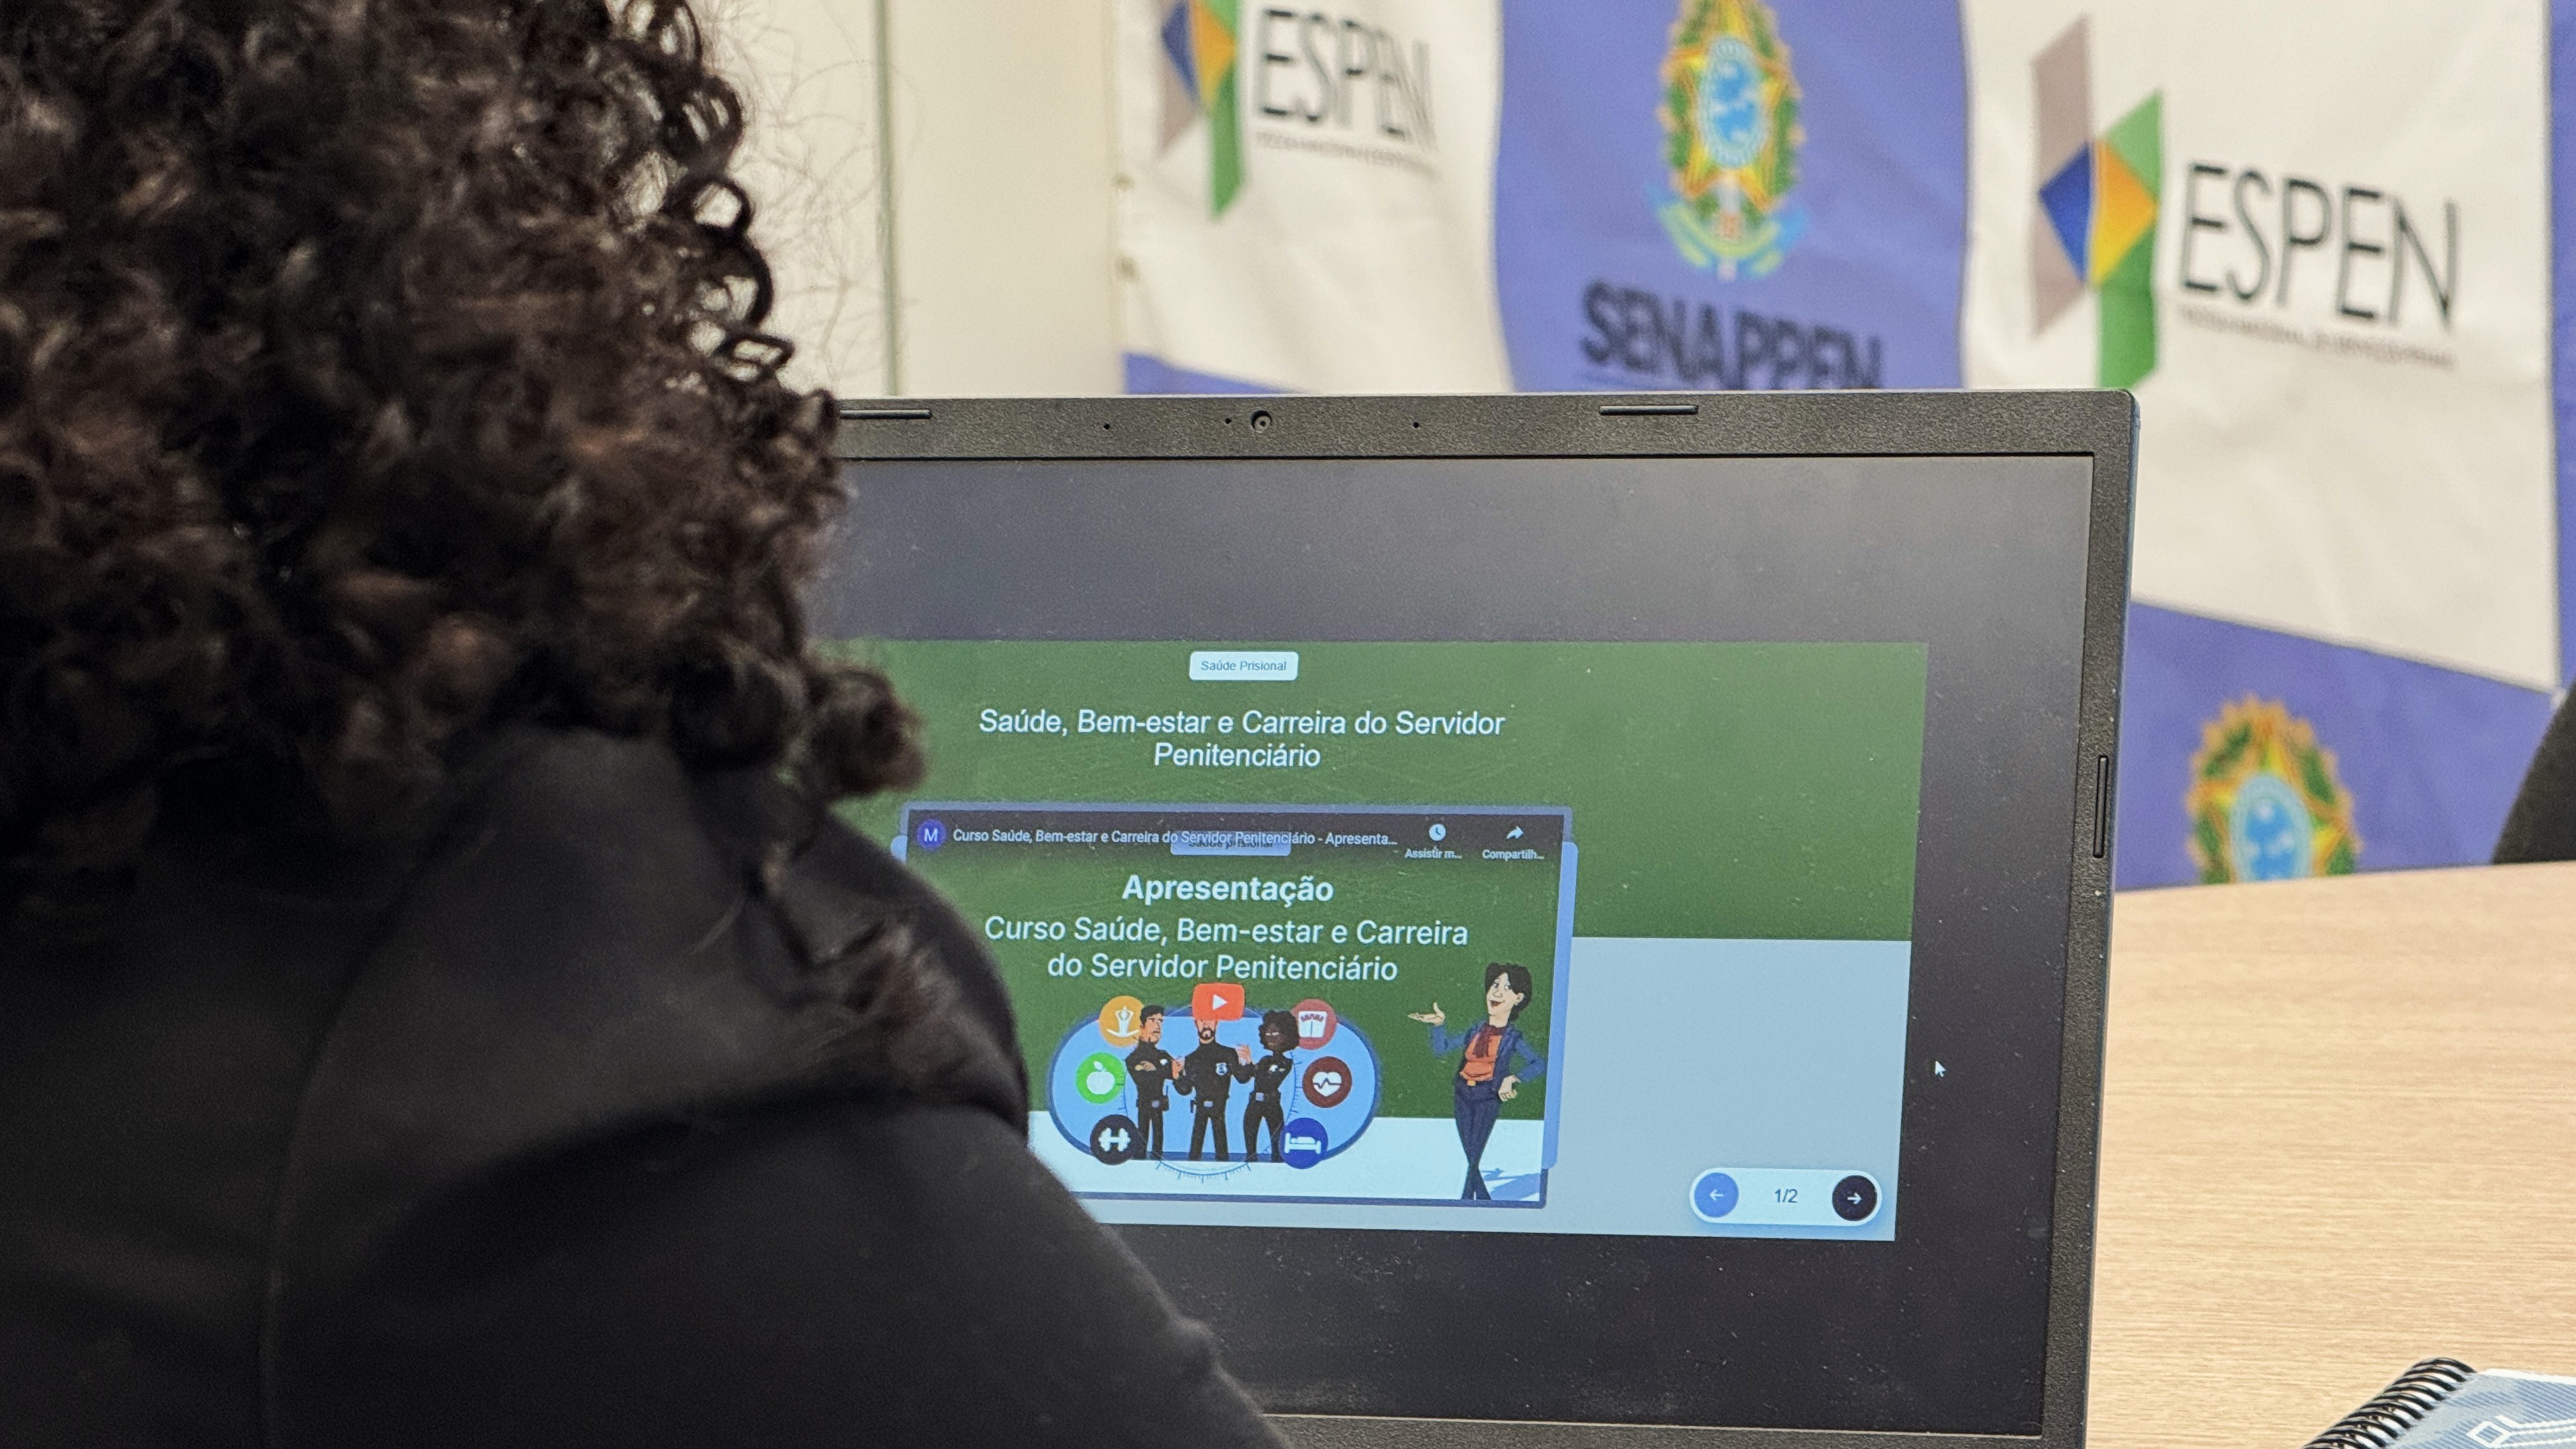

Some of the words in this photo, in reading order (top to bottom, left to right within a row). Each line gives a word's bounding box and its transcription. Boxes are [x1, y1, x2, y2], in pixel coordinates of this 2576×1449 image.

[1254, 9, 1438, 152] ESPEN
[2181, 162, 2459, 330] ESPEN
[1200, 659, 1236, 671] Saúde
[1239, 661, 1287, 671] Prisional
[979, 709, 1068, 737] Saúde,
[1078, 709, 1211, 733] Bem-estar
[1218, 715, 1234, 733] e
[1242, 710, 1346, 734] Carreira
[1354, 710, 1387, 734] do
[1395, 710, 1506, 735] Servidor
[1154, 742, 1321, 767] Penitenciário
[923, 828, 939, 842] M
[953, 830, 988, 842] Curso
[992, 829, 1032, 844] Saúde,
[1036, 830, 1098, 843] Bem-estar
[1101, 833, 1108, 843] e
[1111, 830, 1159, 843] Carreira
[1163, 831, 1177, 843] do
[1181, 831, 1232, 844] Servidor
[1236, 831, 1315, 845] Penitenciário
[1405, 847, 1443, 859] Assistir
[1122, 874, 1334, 907] Apresentação
[985, 916, 1066, 941] Curso
[1074, 916, 1168, 946] Saúde,
[1177, 917, 1324, 944] Bem-estar
[1331, 925, 1347, 944] e
[1356, 919, 1468, 946] Carreira
[1048, 953, 1082, 977] do
[1091, 953, 1209, 978] Servidor
[1216, 954, 1398, 981] Penitenciário
[1774, 1188, 1798, 1204] 1/2
